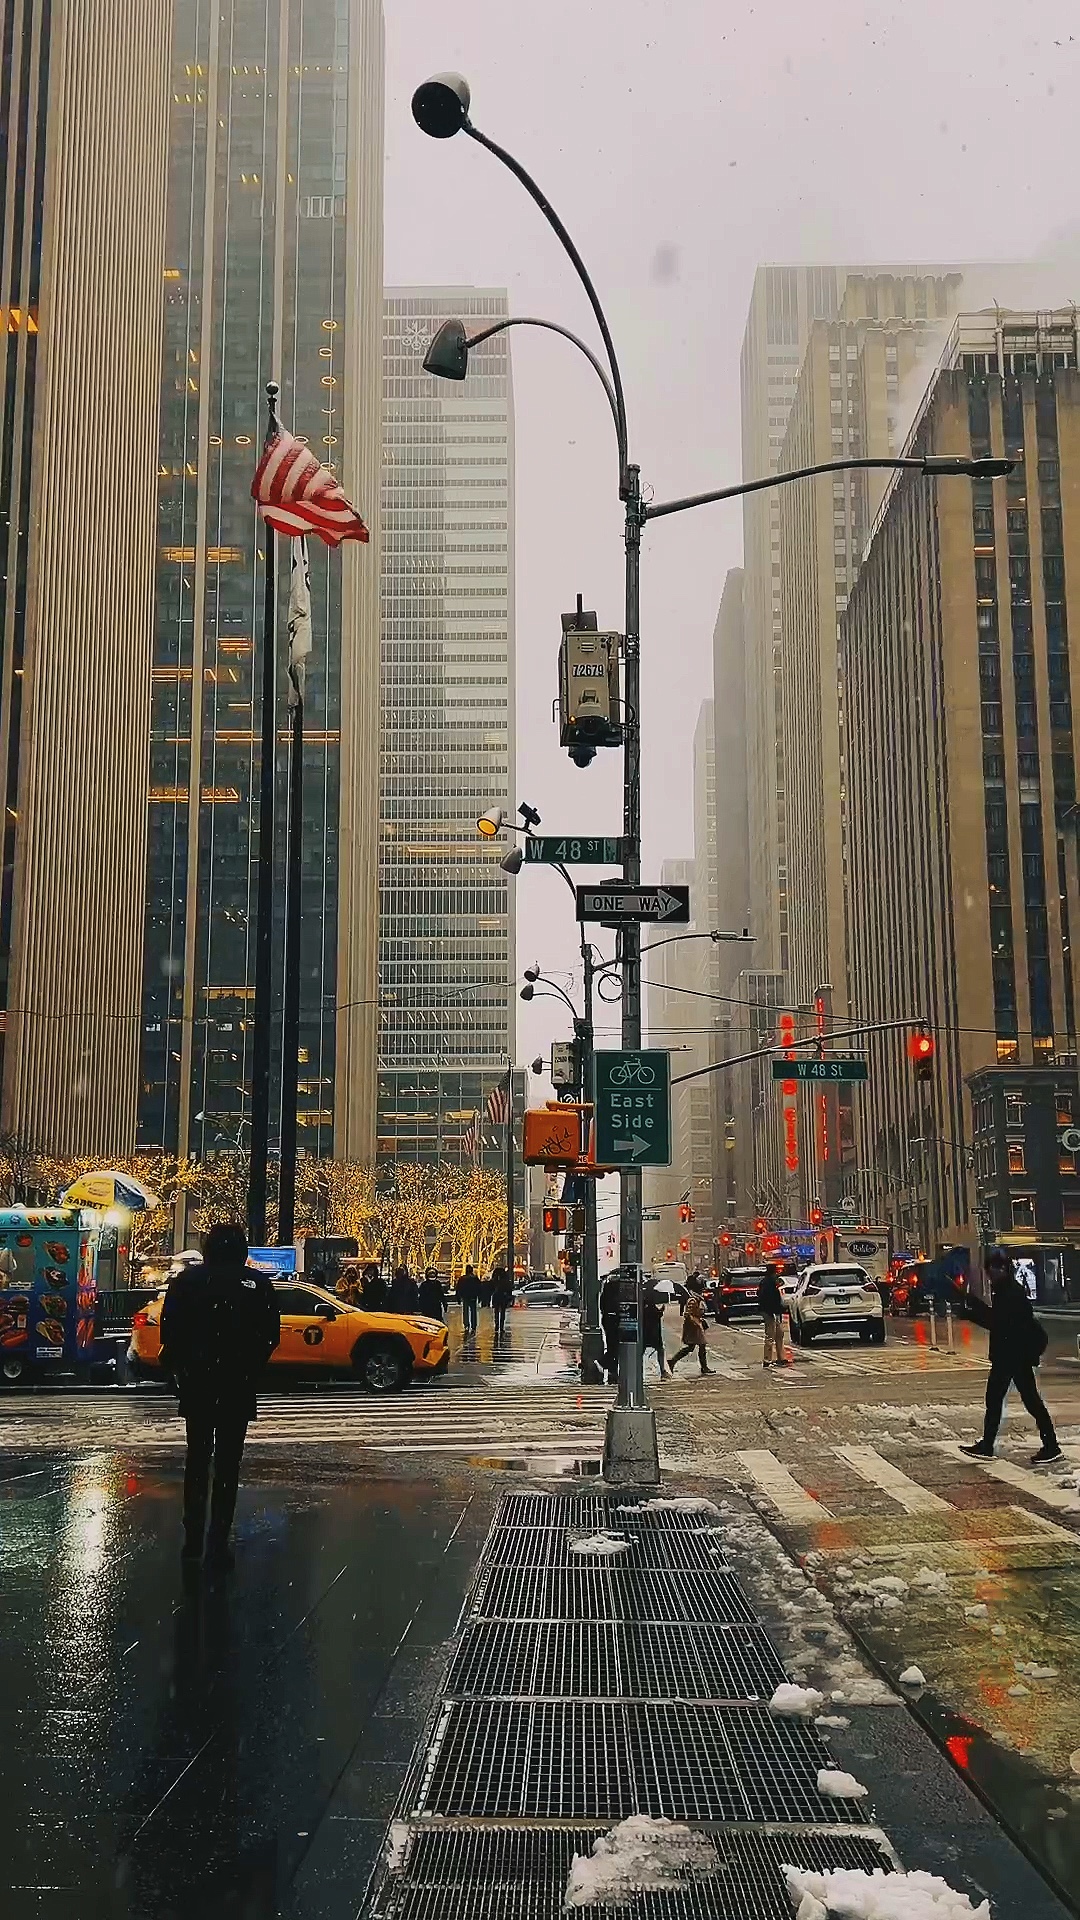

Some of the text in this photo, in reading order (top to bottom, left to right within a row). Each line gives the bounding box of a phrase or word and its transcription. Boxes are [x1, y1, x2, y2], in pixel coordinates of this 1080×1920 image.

[572, 664, 605, 678] 72679
[529, 839, 600, 860] W 48 ST
[592, 896, 672, 911] ONE WAY
[780, 1015, 798, 1095] RADO
[797, 1063, 843, 1077] W 48 St
[610, 1093, 654, 1108] East
[611, 1114, 654, 1129] Side
